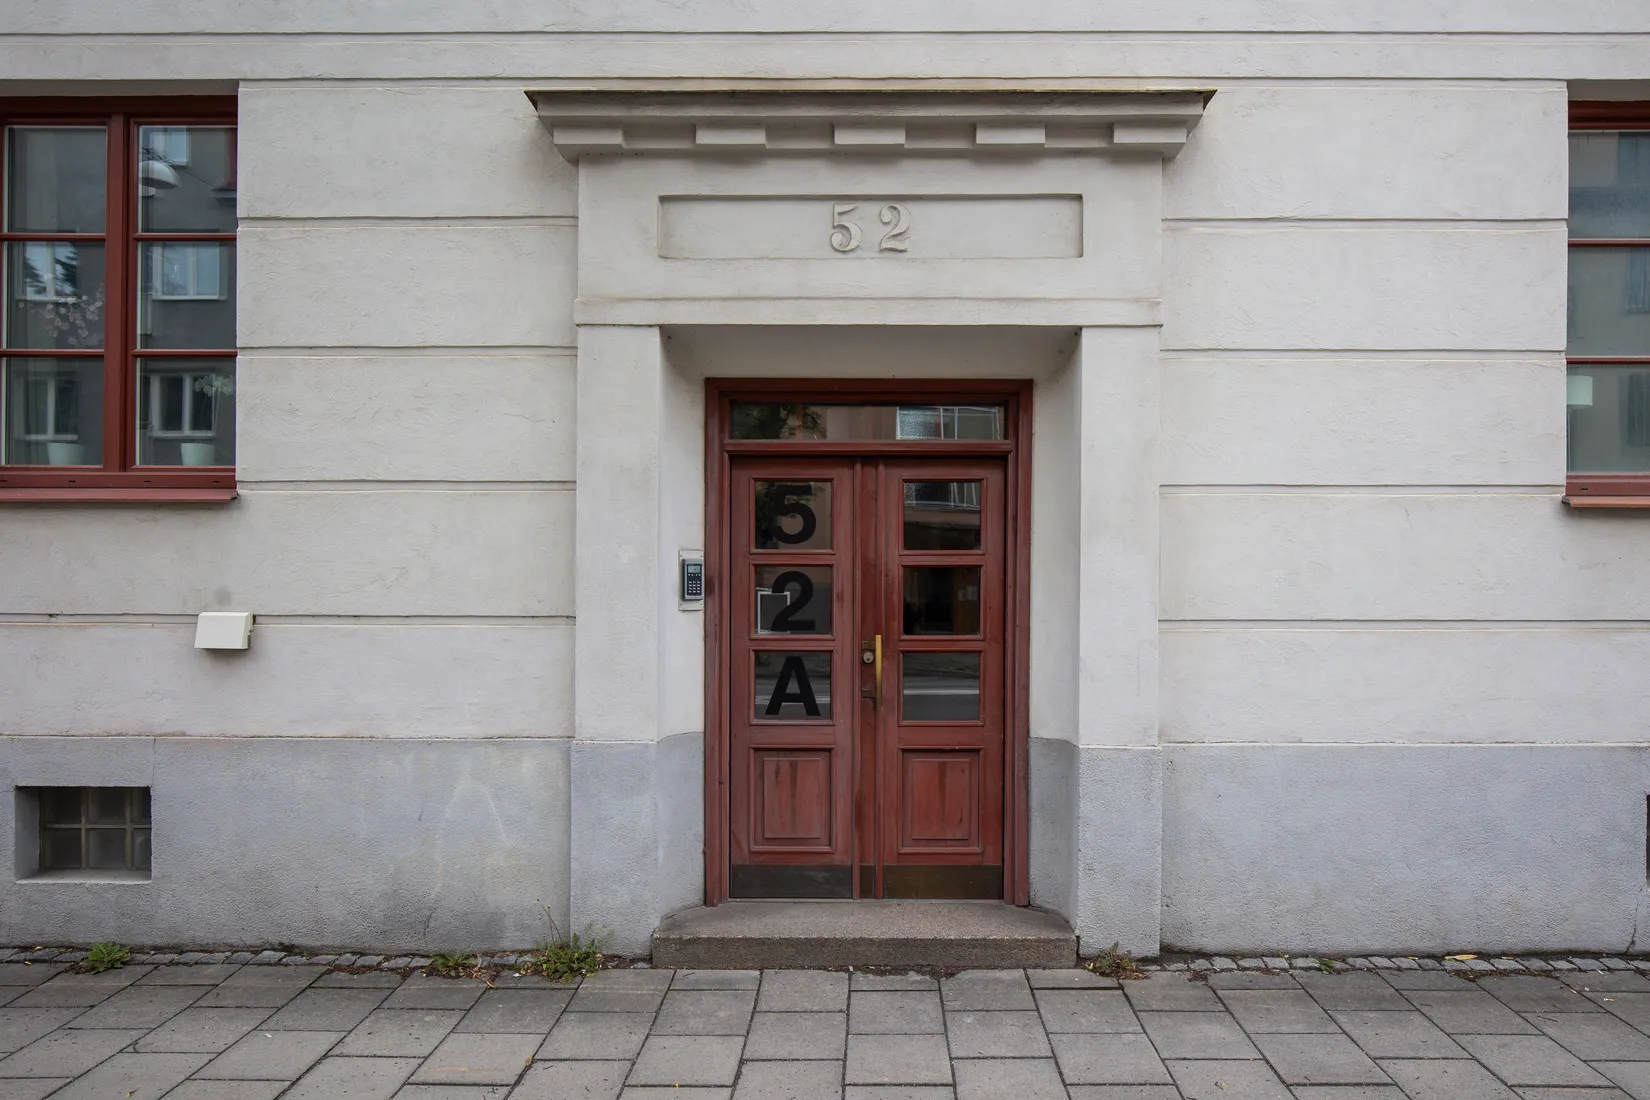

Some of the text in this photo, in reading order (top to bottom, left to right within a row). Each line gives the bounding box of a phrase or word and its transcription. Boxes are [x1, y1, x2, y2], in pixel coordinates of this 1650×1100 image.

[829, 203, 911, 252] 52
[772, 485, 816, 544] 5
[771, 571, 816, 631] 2
[765, 656, 821, 716] A
